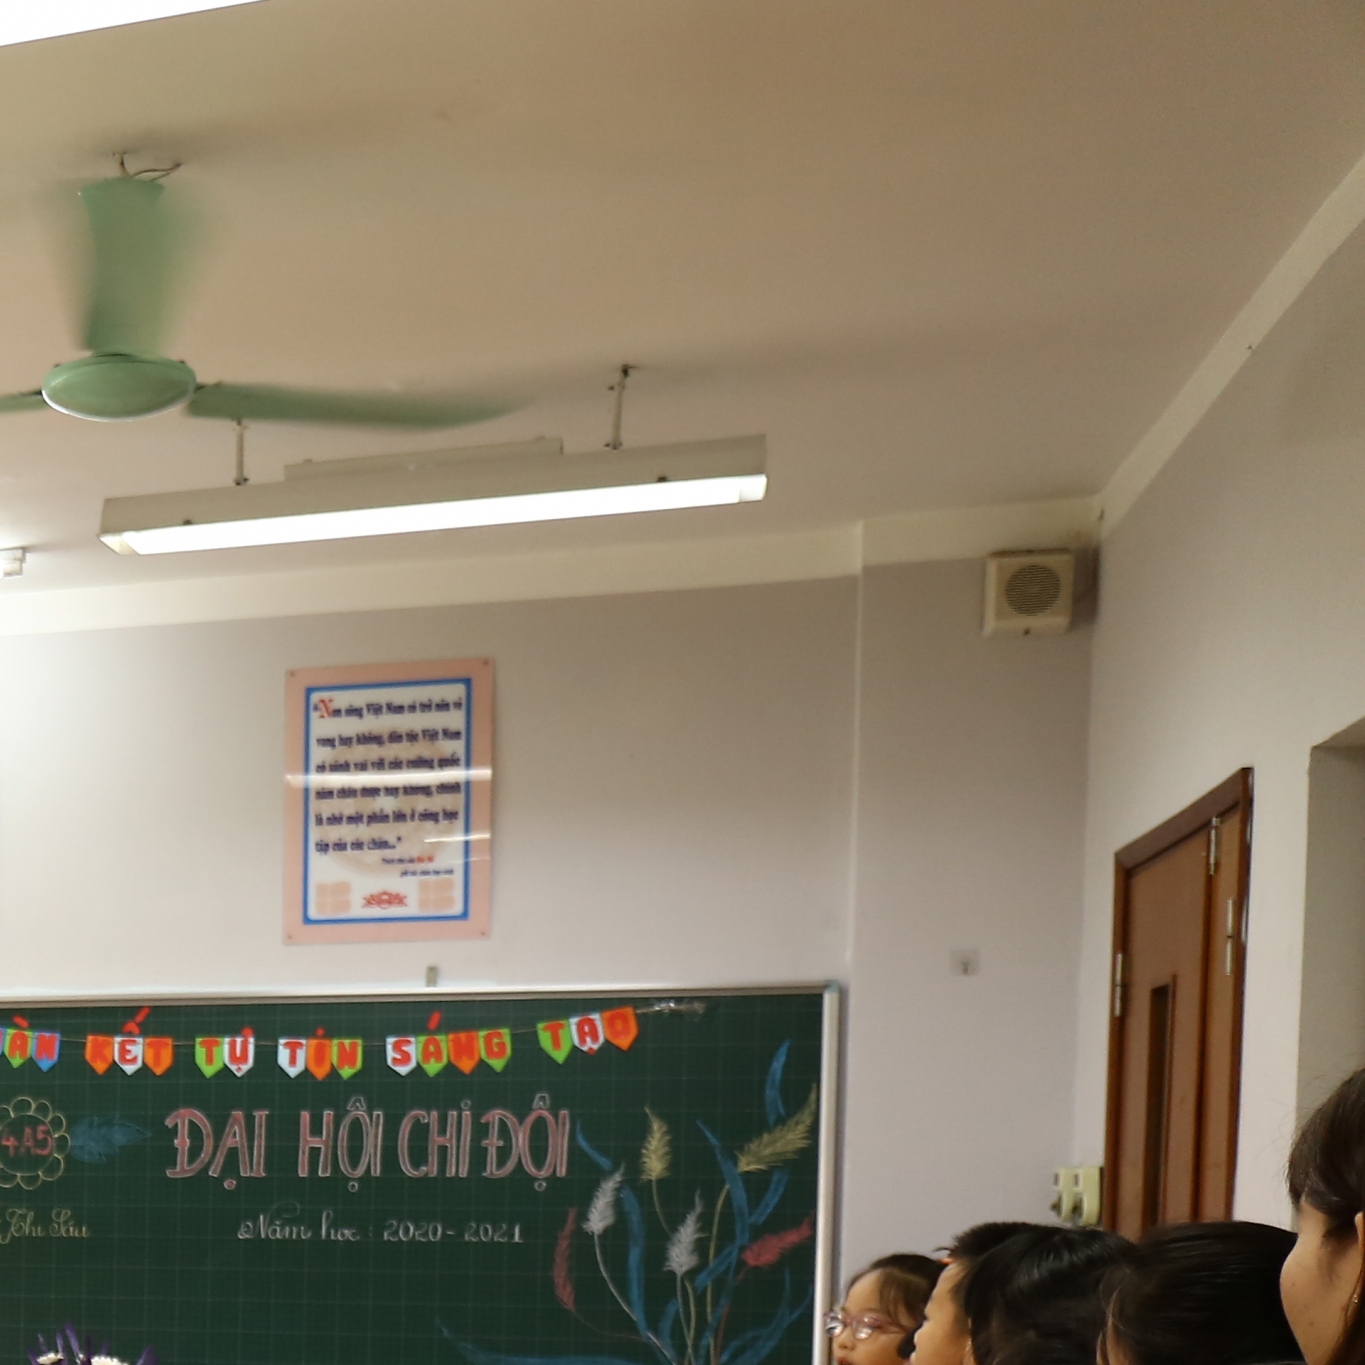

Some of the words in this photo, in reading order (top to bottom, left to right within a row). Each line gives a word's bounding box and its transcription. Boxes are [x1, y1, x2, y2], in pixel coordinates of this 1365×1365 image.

[1, 1124, 53, 1157] 4A5
[165, 1107, 269, 1191] ĐẠI
[298, 1095, 384, 1193] HỘI
[480, 1093, 569, 1192] ĐỘI
